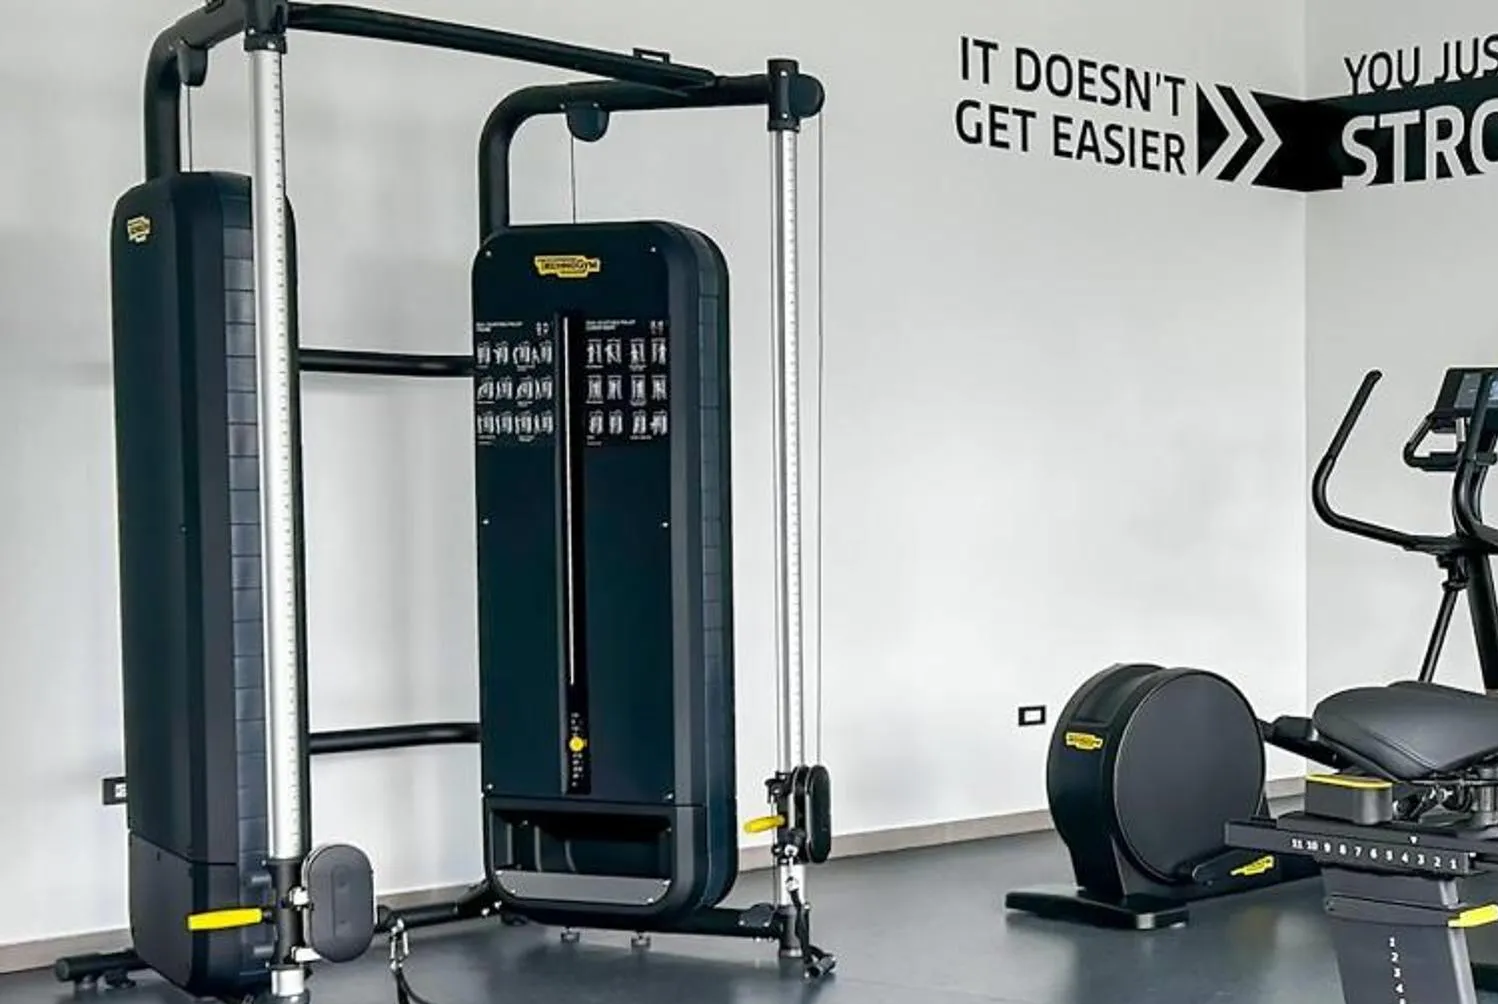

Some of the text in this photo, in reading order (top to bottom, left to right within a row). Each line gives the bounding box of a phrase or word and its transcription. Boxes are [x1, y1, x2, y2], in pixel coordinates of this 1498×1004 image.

[961, 36, 1186, 117] IT DOESN'T
[1344, 46, 1421, 95] YOU
[955, 99, 1186, 175] GET EASIER
[1291, 838, 1303, 850] 11
[1306, 840, 1319, 851] 10
[1323, 842, 1332, 853] 9
[1354, 846, 1363, 857] 7
[1369, 848, 1378, 859] 6
[1401, 852, 1410, 863] 4
[1417, 853, 1425, 865] 3
[1433, 856, 1442, 868] 2
[1449, 858, 1457, 870] 1
[1391, 951, 1399, 963] 2
[1395, 983, 1404, 994] 4
